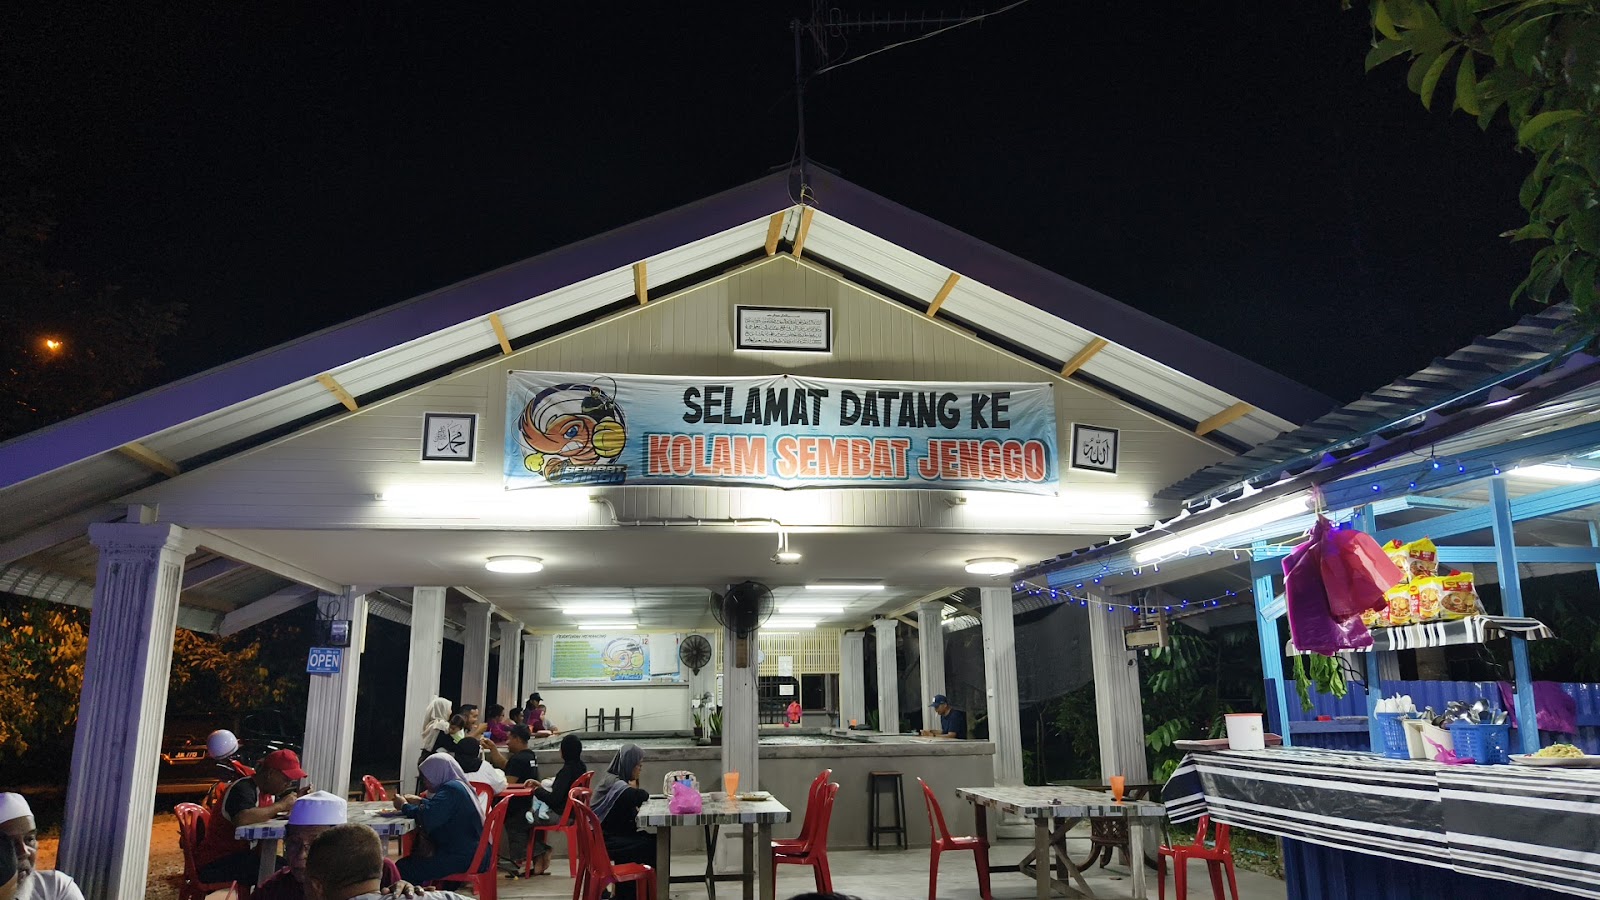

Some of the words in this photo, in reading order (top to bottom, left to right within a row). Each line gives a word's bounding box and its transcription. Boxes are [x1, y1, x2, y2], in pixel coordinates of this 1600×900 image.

[682, 385, 829, 426] SELAMAT
[840, 389, 961, 430] DATANG
[971, 391, 1011, 430] KE
[648, 434, 768, 477] KOLAM
[776, 435, 911, 479] SEMBAT
[917, 438, 1047, 482] JENGGO
[309, 653, 340, 668] OPEN
